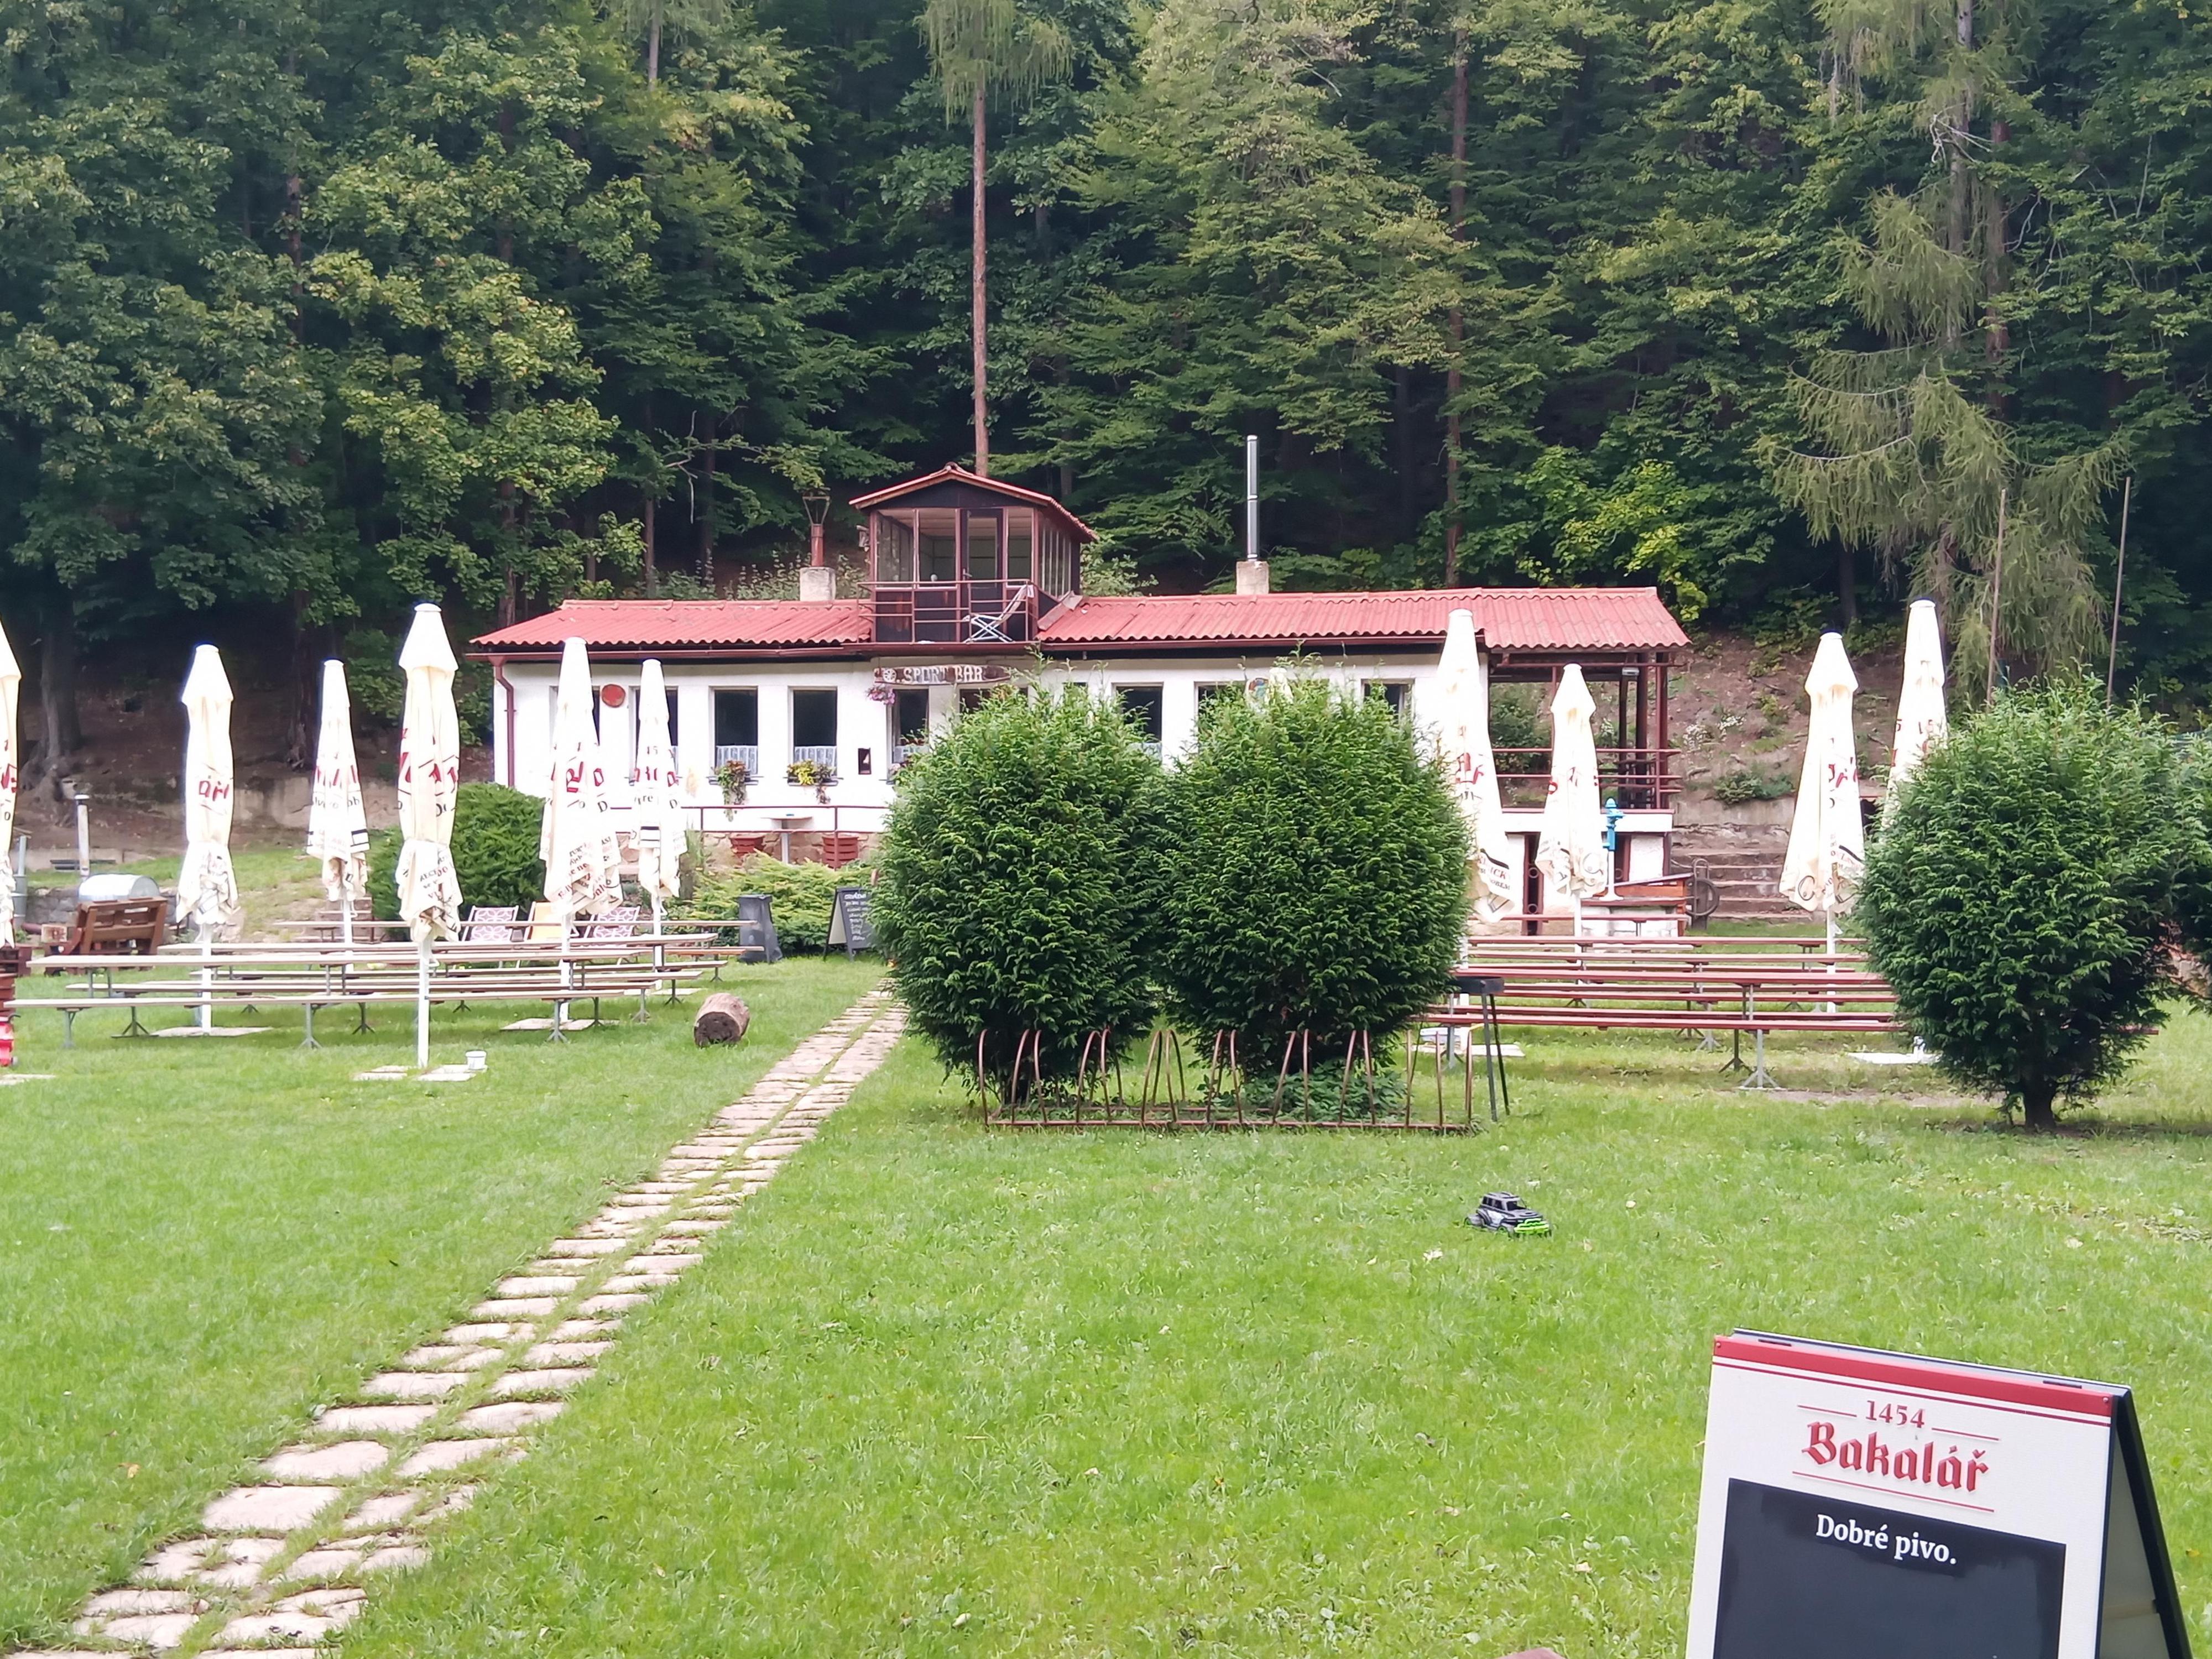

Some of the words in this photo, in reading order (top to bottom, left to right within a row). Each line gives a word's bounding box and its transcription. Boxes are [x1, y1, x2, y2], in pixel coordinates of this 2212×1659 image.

[904, 667, 949, 684] SPORT
[954, 665, 983, 682] BAR
[1865, 1400, 1925, 1428] 1454
[1802, 1422, 1989, 1492] Bakalář
[1816, 1515, 1888, 1550] Dobré
[1894, 1532, 1957, 1564] pivo.
